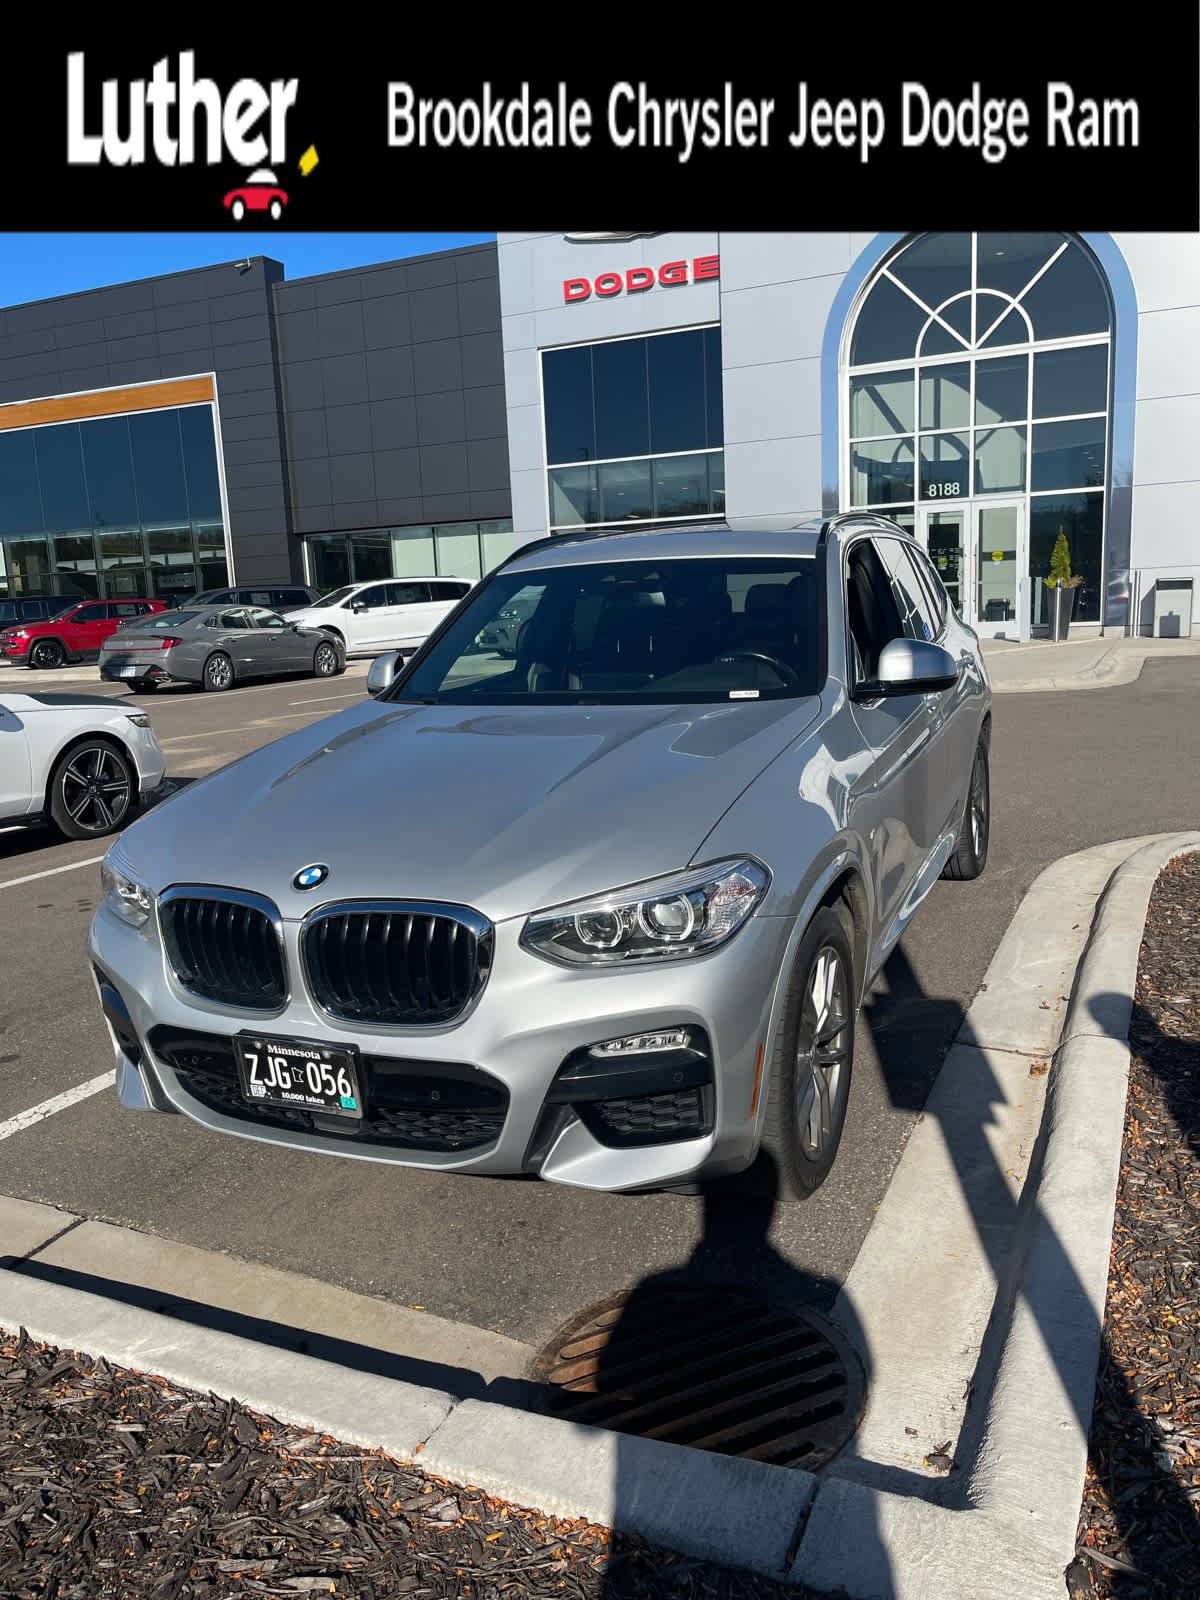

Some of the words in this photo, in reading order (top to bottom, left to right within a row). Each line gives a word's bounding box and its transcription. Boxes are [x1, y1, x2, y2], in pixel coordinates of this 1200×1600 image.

[563, 254, 720, 304] DODGE
[928, 482, 960, 496] 8188
[267, 1044, 321, 1060] Minnesota
[244, 1053, 292, 1089] ZJG
[305, 1061, 352, 1097] 056
[281, 1092, 304, 1101] 10,000
